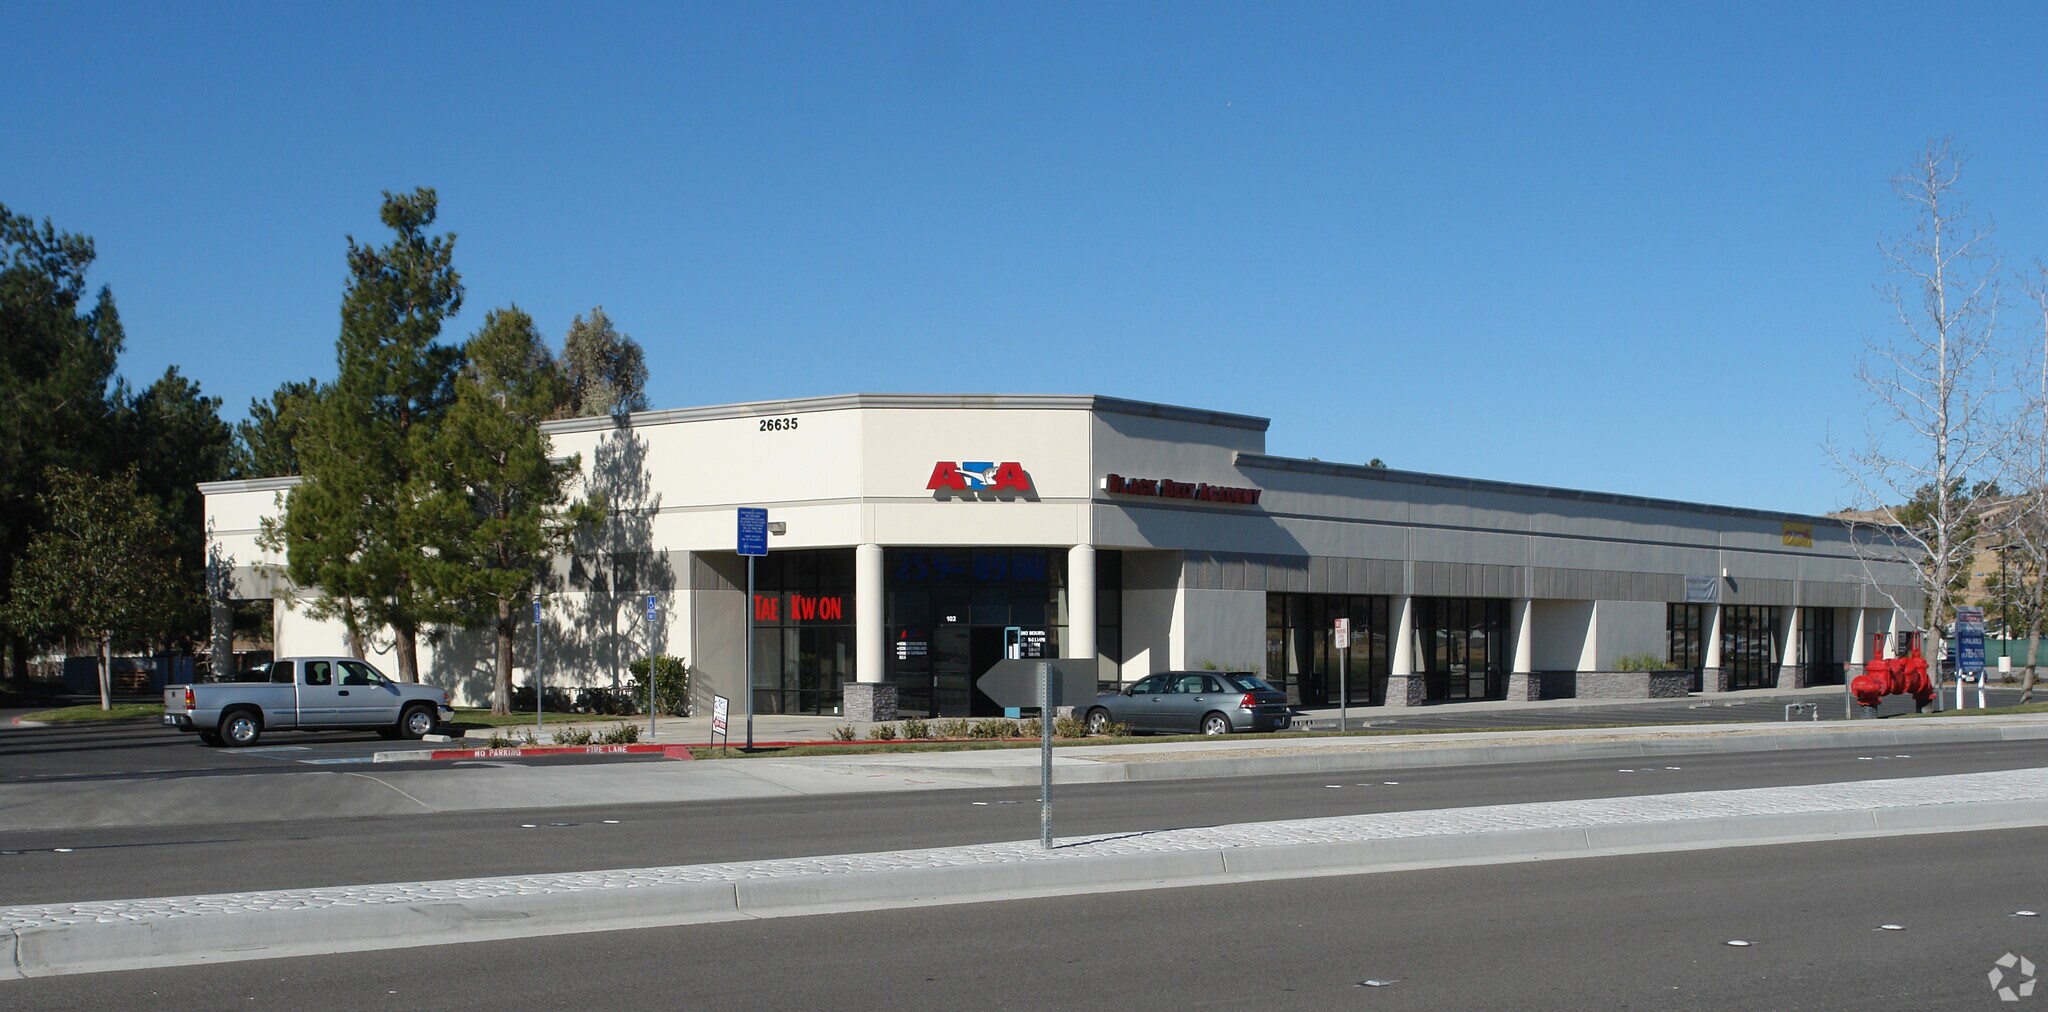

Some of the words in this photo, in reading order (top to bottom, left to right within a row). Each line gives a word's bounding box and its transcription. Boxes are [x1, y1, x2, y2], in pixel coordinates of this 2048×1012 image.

[759, 418, 798, 432] 26635
[926, 461, 1030, 491] ATA
[754, 594, 779, 621] TAE
[475, 749, 486, 758] NO
[489, 748, 522, 757] PARKING
[586, 746, 603, 754] FIRE
[608, 745, 628, 753] LANE
